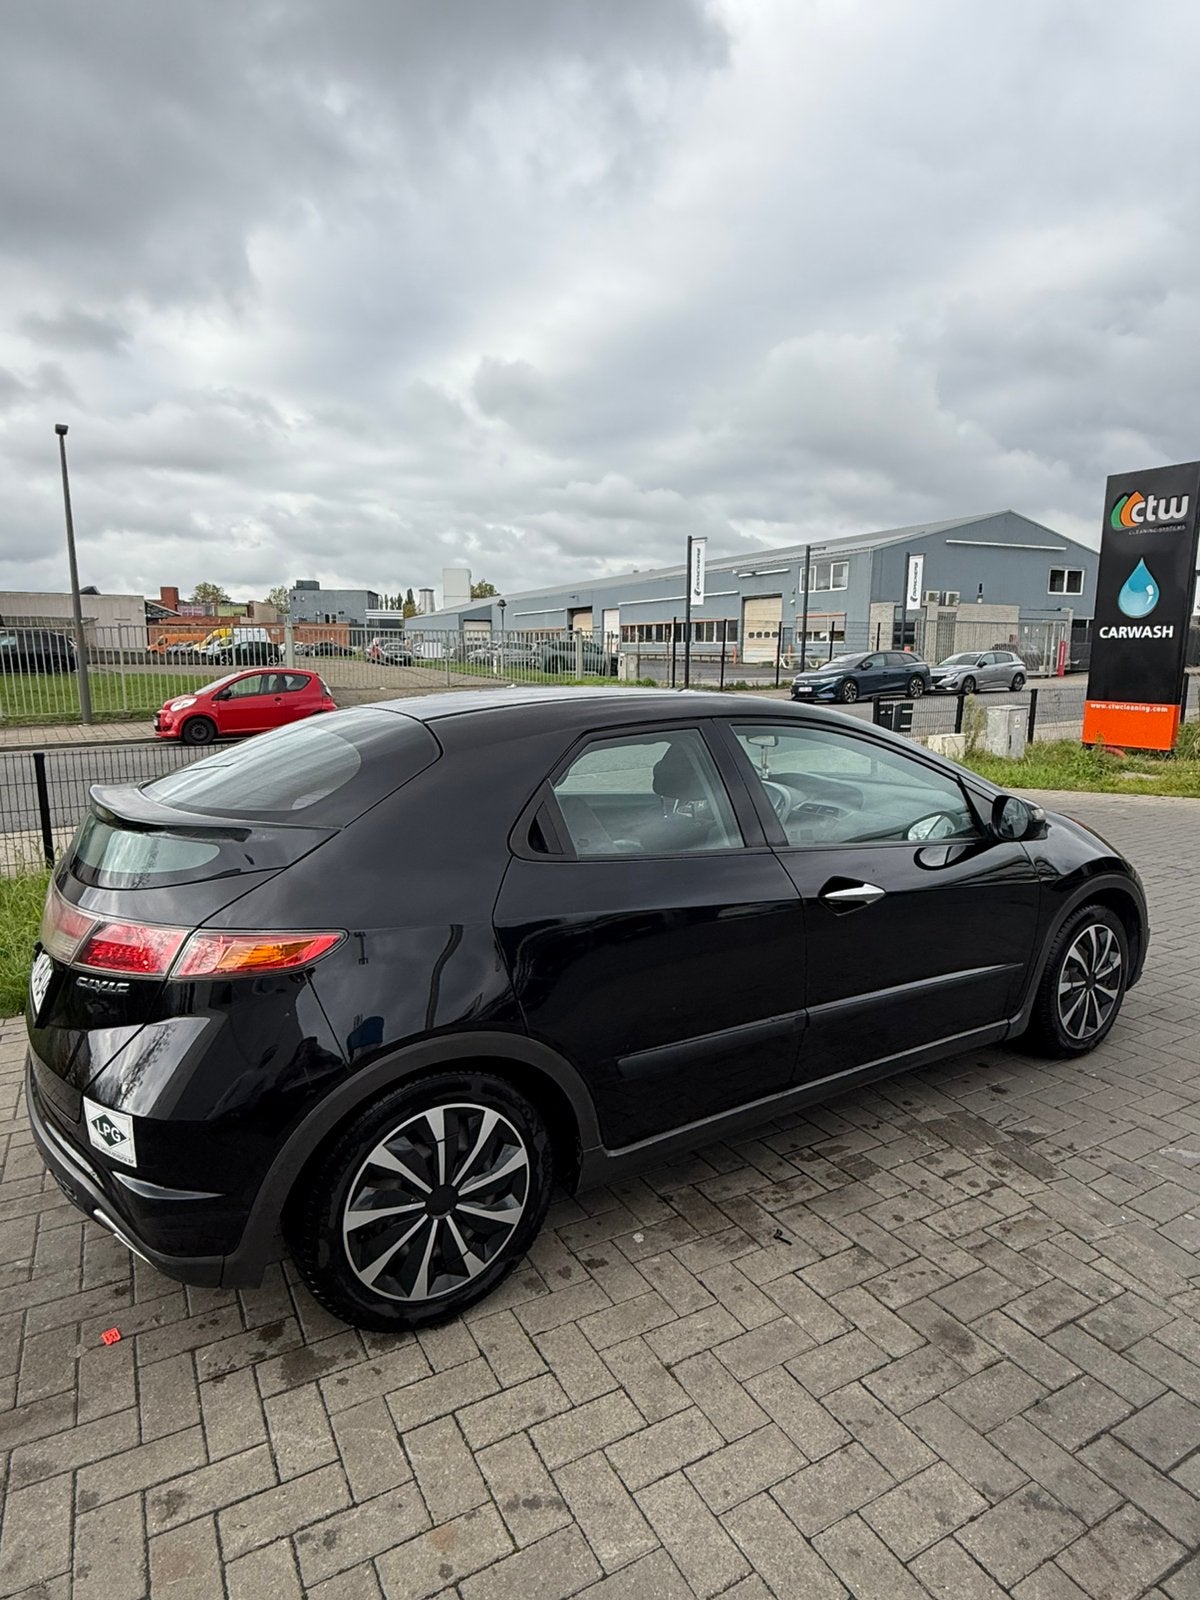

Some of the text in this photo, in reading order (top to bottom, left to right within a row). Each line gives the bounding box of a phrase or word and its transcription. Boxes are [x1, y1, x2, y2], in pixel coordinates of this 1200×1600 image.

[1131, 495, 1189, 522] ctw
[1099, 625, 1174, 639] CARWASH
[1090, 703, 1168, 713] www.ctwcleaning.com
[76, 976, 130, 993] CIVIC
[96, 1119, 121, 1143] LPG
